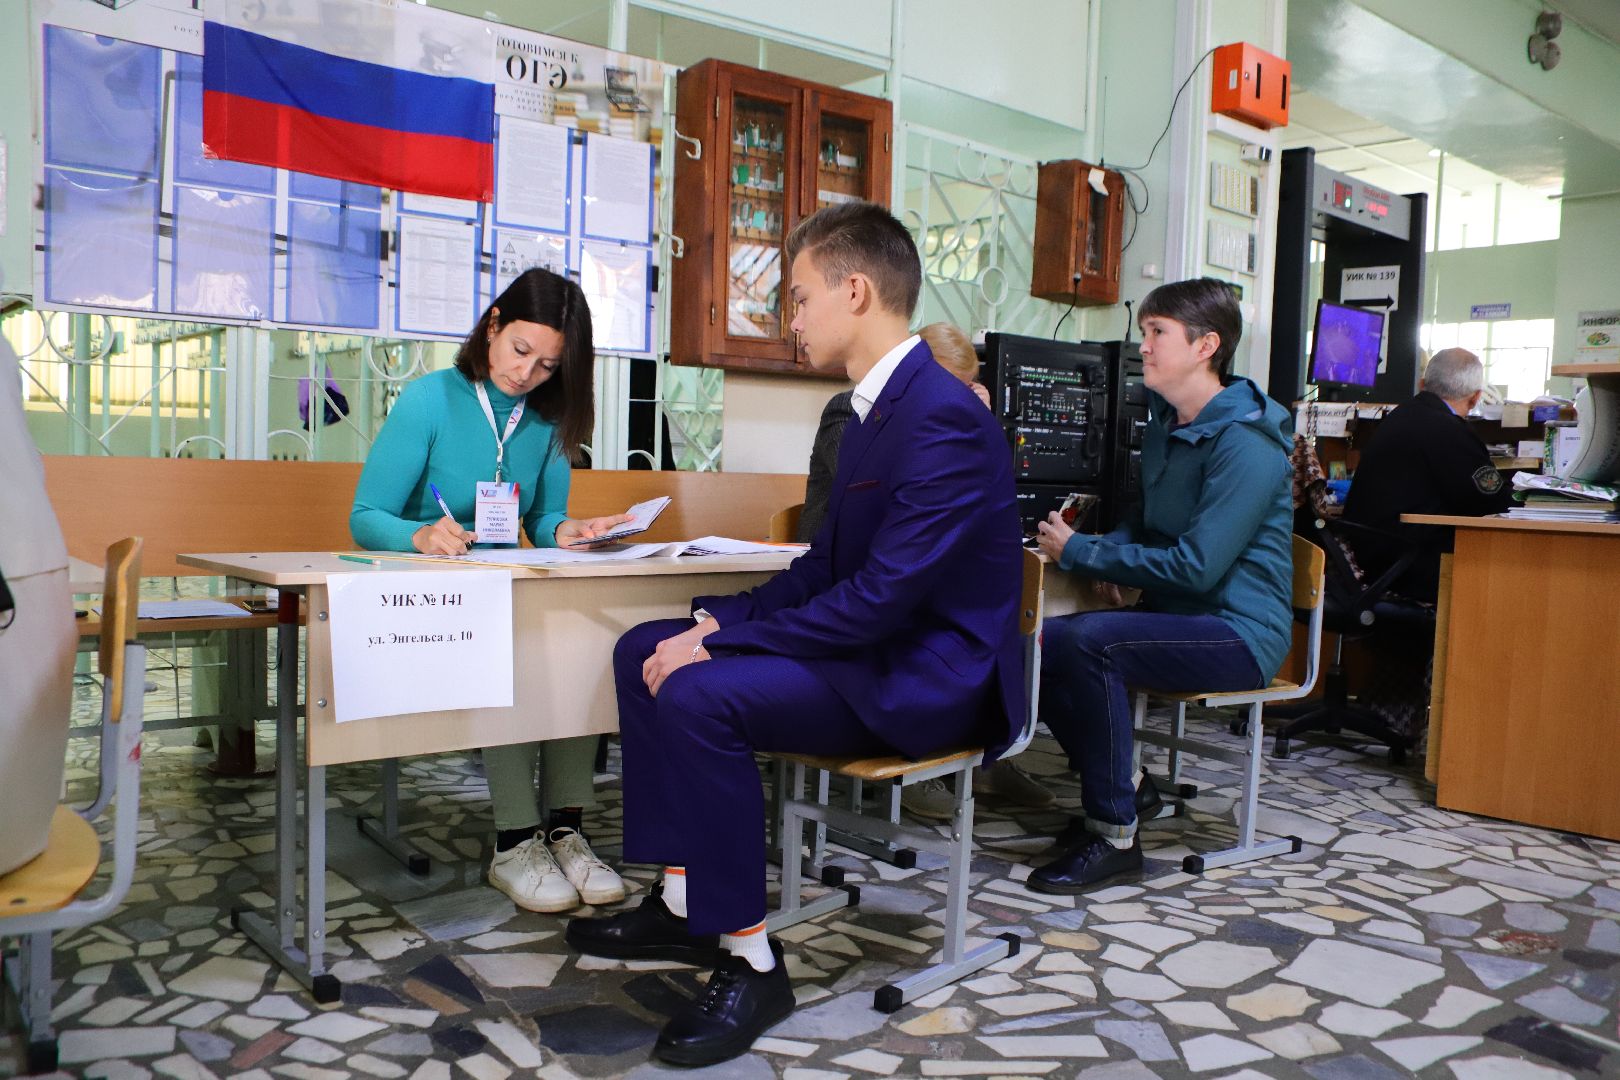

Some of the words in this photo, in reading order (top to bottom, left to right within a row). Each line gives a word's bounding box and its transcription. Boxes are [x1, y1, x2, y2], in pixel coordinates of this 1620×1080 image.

[496, 35, 566, 61] ГОТОВИМСЯ
[571, 51, 579, 64] К
[506, 54, 568, 90] ОГЭ
[1346, 272, 1364, 281] УИК
[1366, 272, 1377, 281] №
[1380, 271, 1396, 280] 139
[381, 593, 417, 607] УИК
[419, 593, 437, 607] №
[441, 593, 463, 606] 141
[367, 634, 385, 648] ул.
[388, 632, 444, 644] Энгельса
[446, 633, 456, 643] д.
[460, 630, 473, 641] 10
